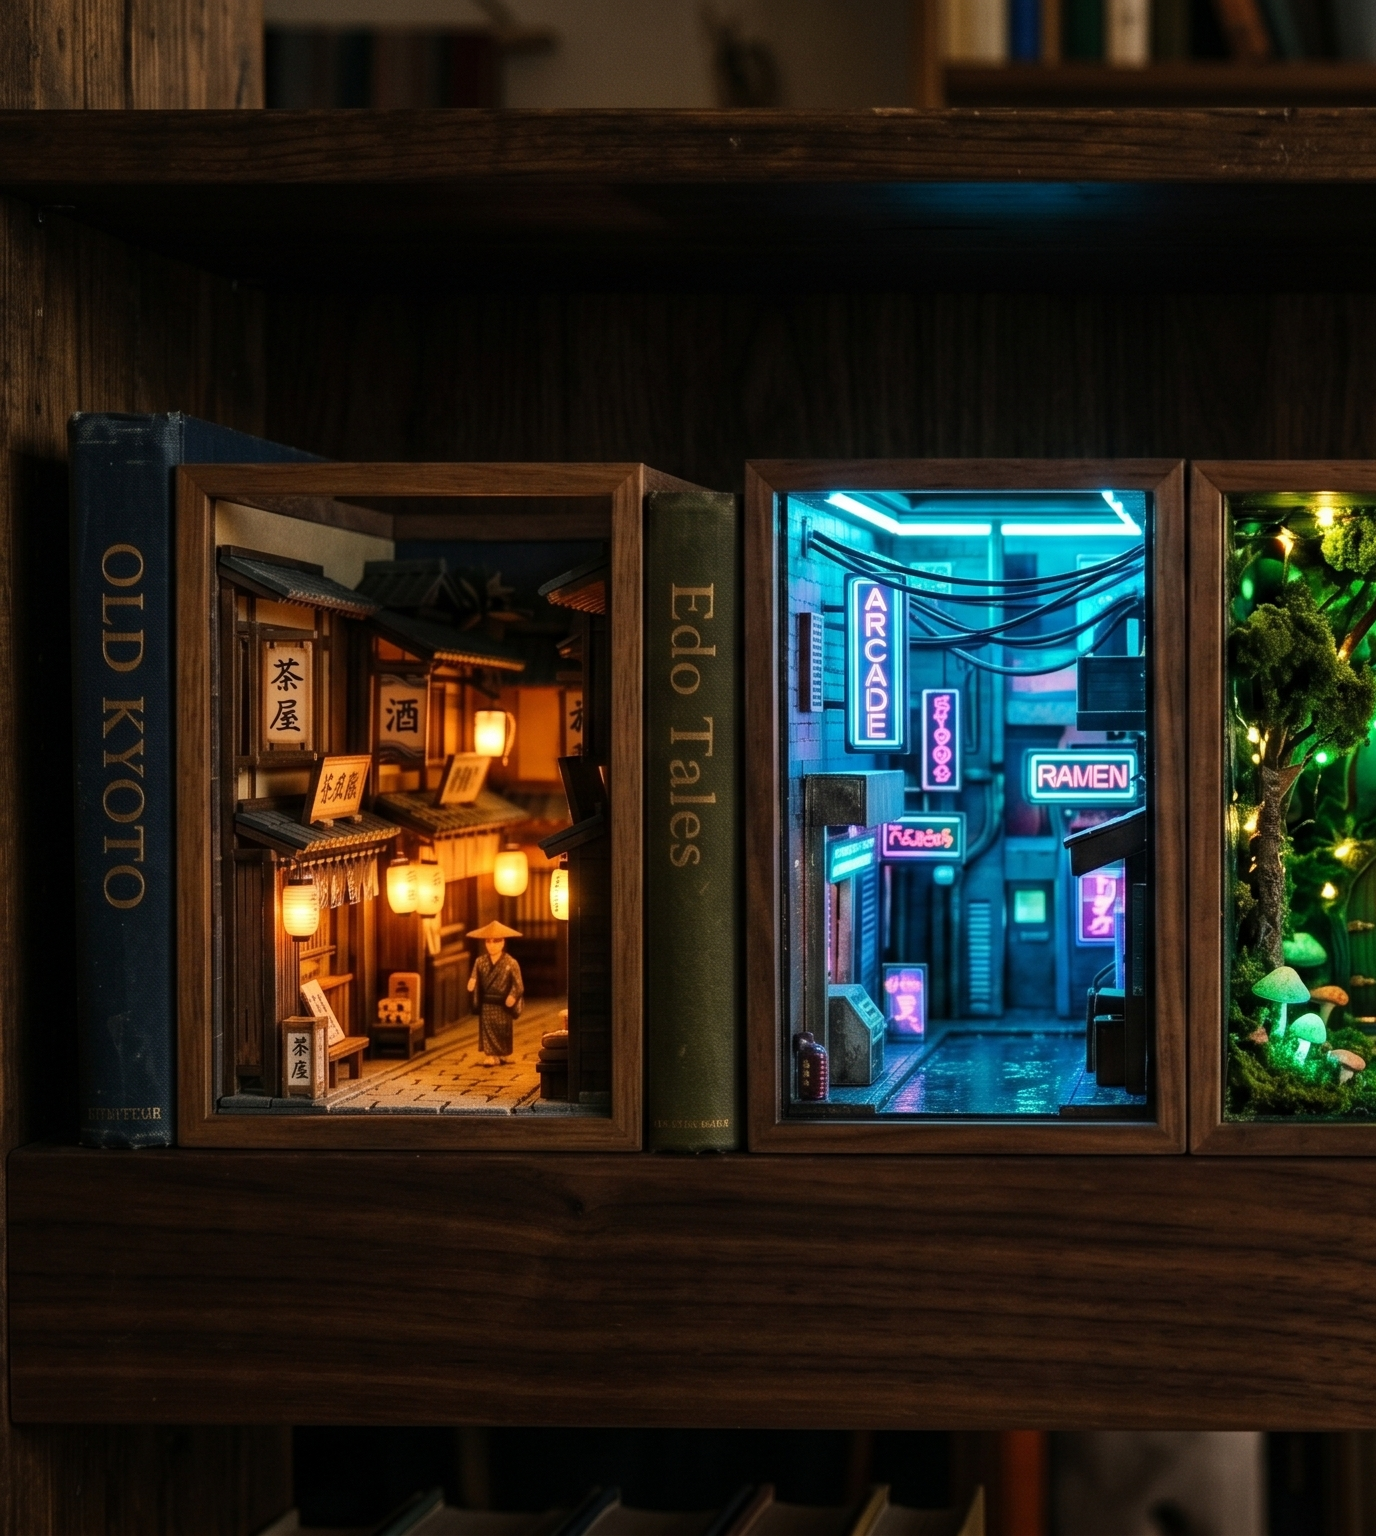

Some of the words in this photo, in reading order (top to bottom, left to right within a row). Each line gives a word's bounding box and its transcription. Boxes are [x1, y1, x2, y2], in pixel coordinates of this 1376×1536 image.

[101, 543, 144, 672] OLD
[670, 582, 716, 695] Edo
[864, 587, 888, 739] ARCADE
[269, 657, 304, 732] 茶屋
[385, 697, 419, 734] 酒
[102, 696, 145, 909] KYOTO
[669, 716, 716, 868] Tales
[1037, 764, 1128, 789] RAMEN
